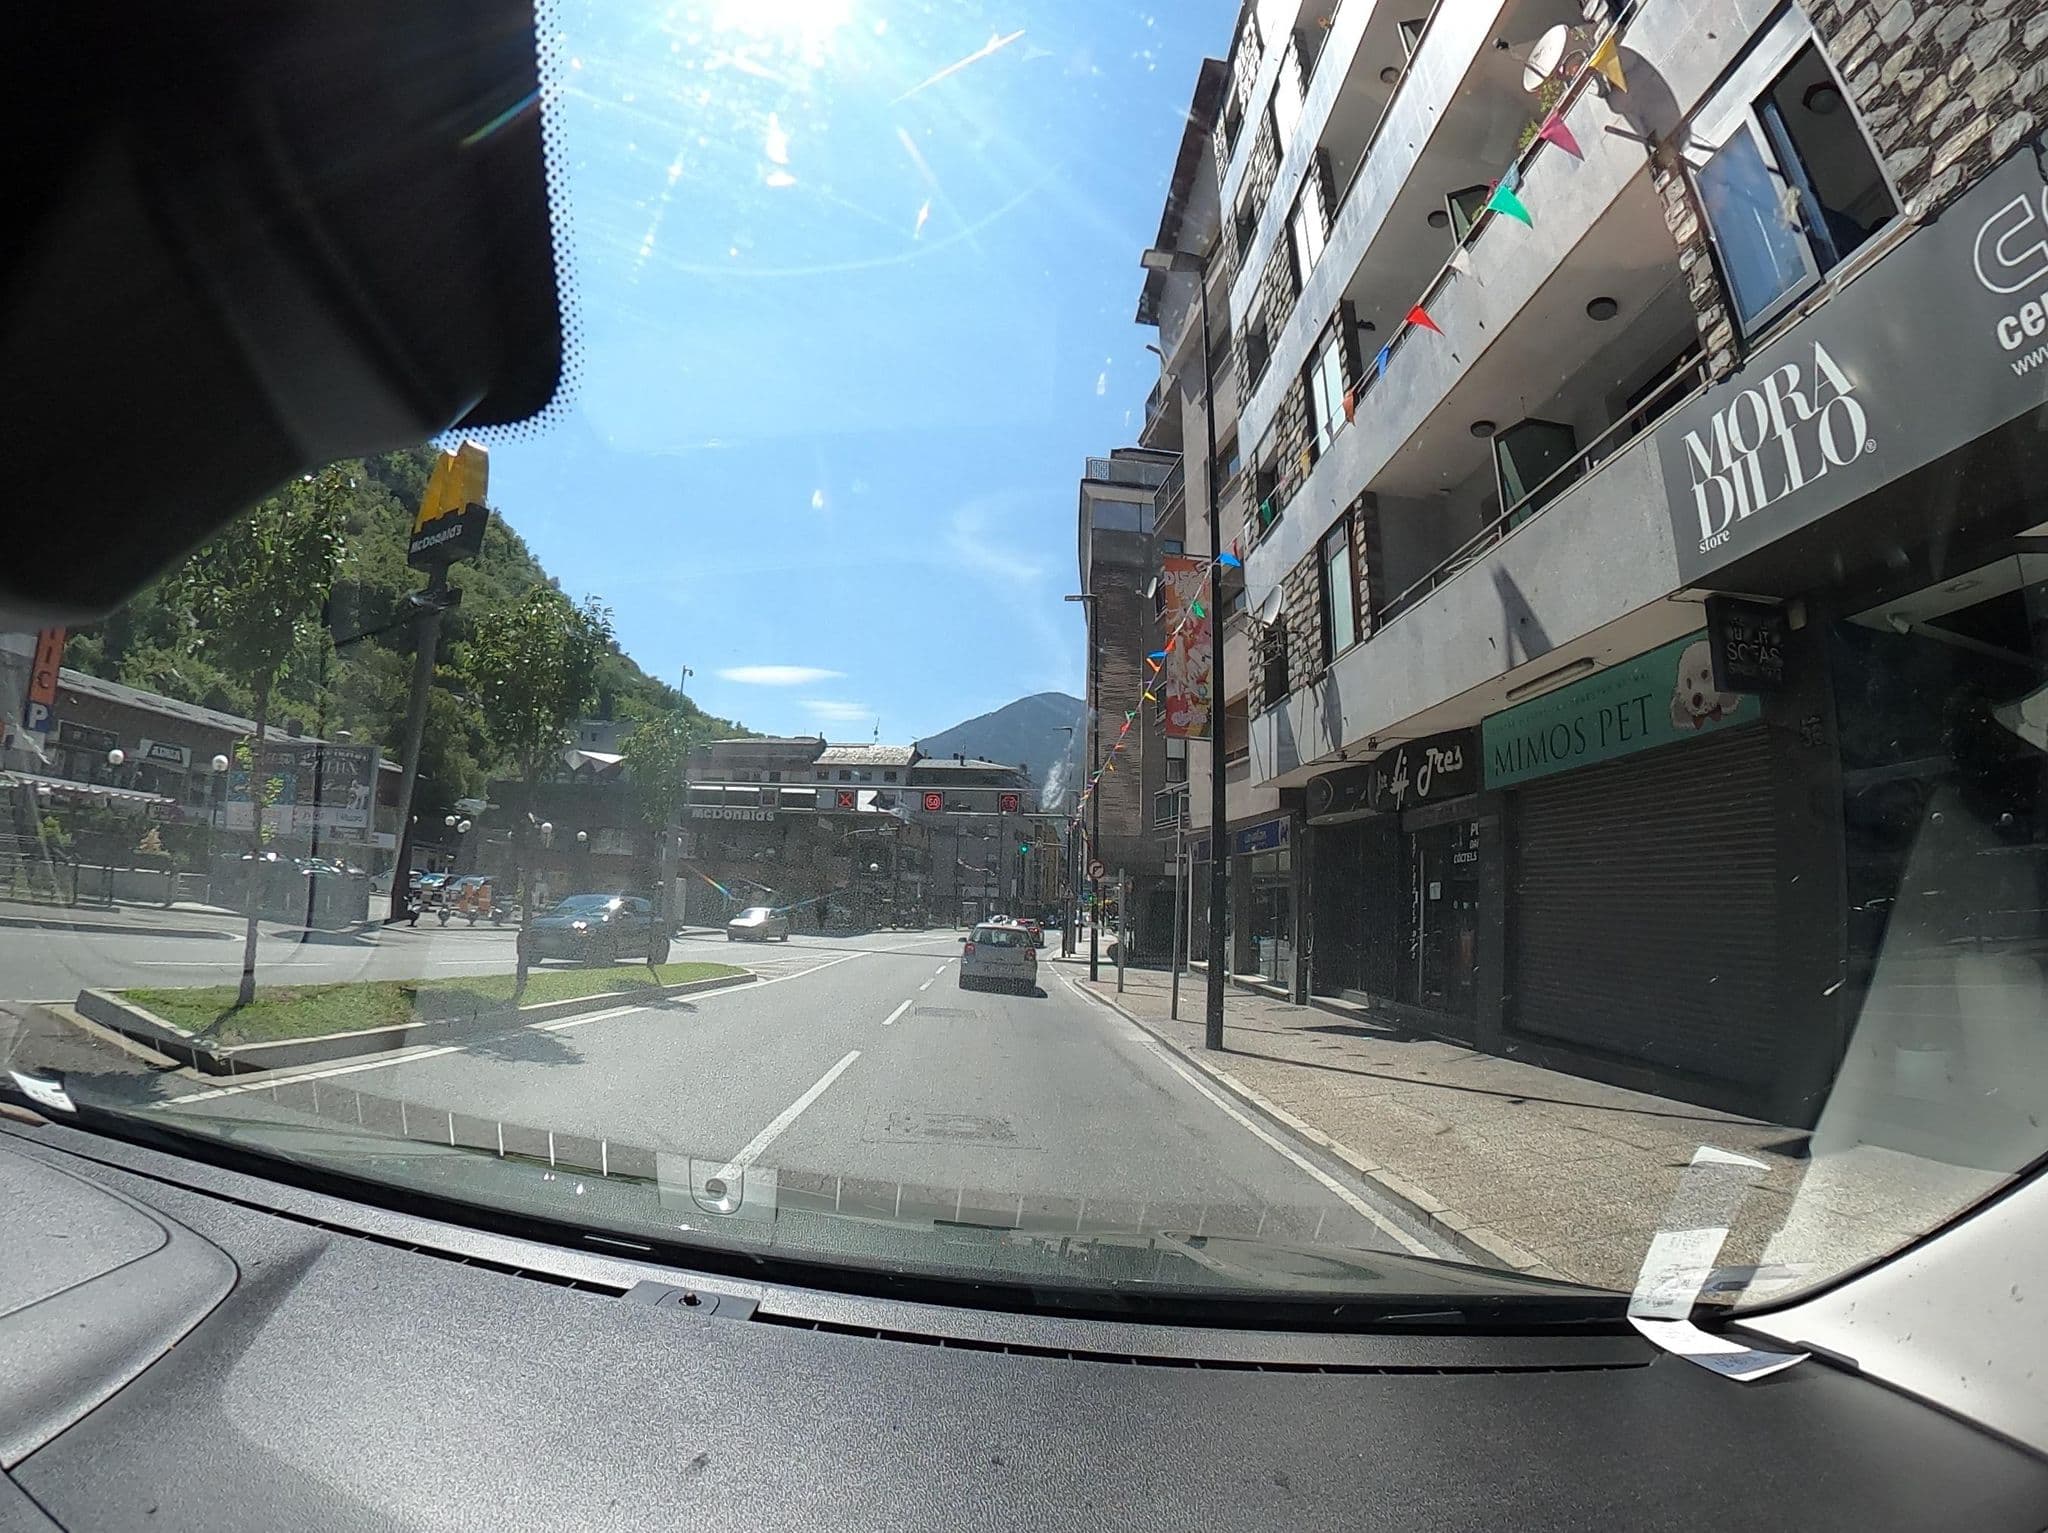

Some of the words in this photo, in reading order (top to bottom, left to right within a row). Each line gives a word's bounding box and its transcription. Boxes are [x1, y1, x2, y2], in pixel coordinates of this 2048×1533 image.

[1681, 341, 1856, 491] MORA
[1691, 395, 1867, 543] DILLO
[1699, 529, 1731, 554] store
[28, 703, 49, 728] P
[1495, 716, 1586, 777] MIMOS
[1600, 693, 1653, 748] PET
[1417, 745, 1463, 797] Tres
